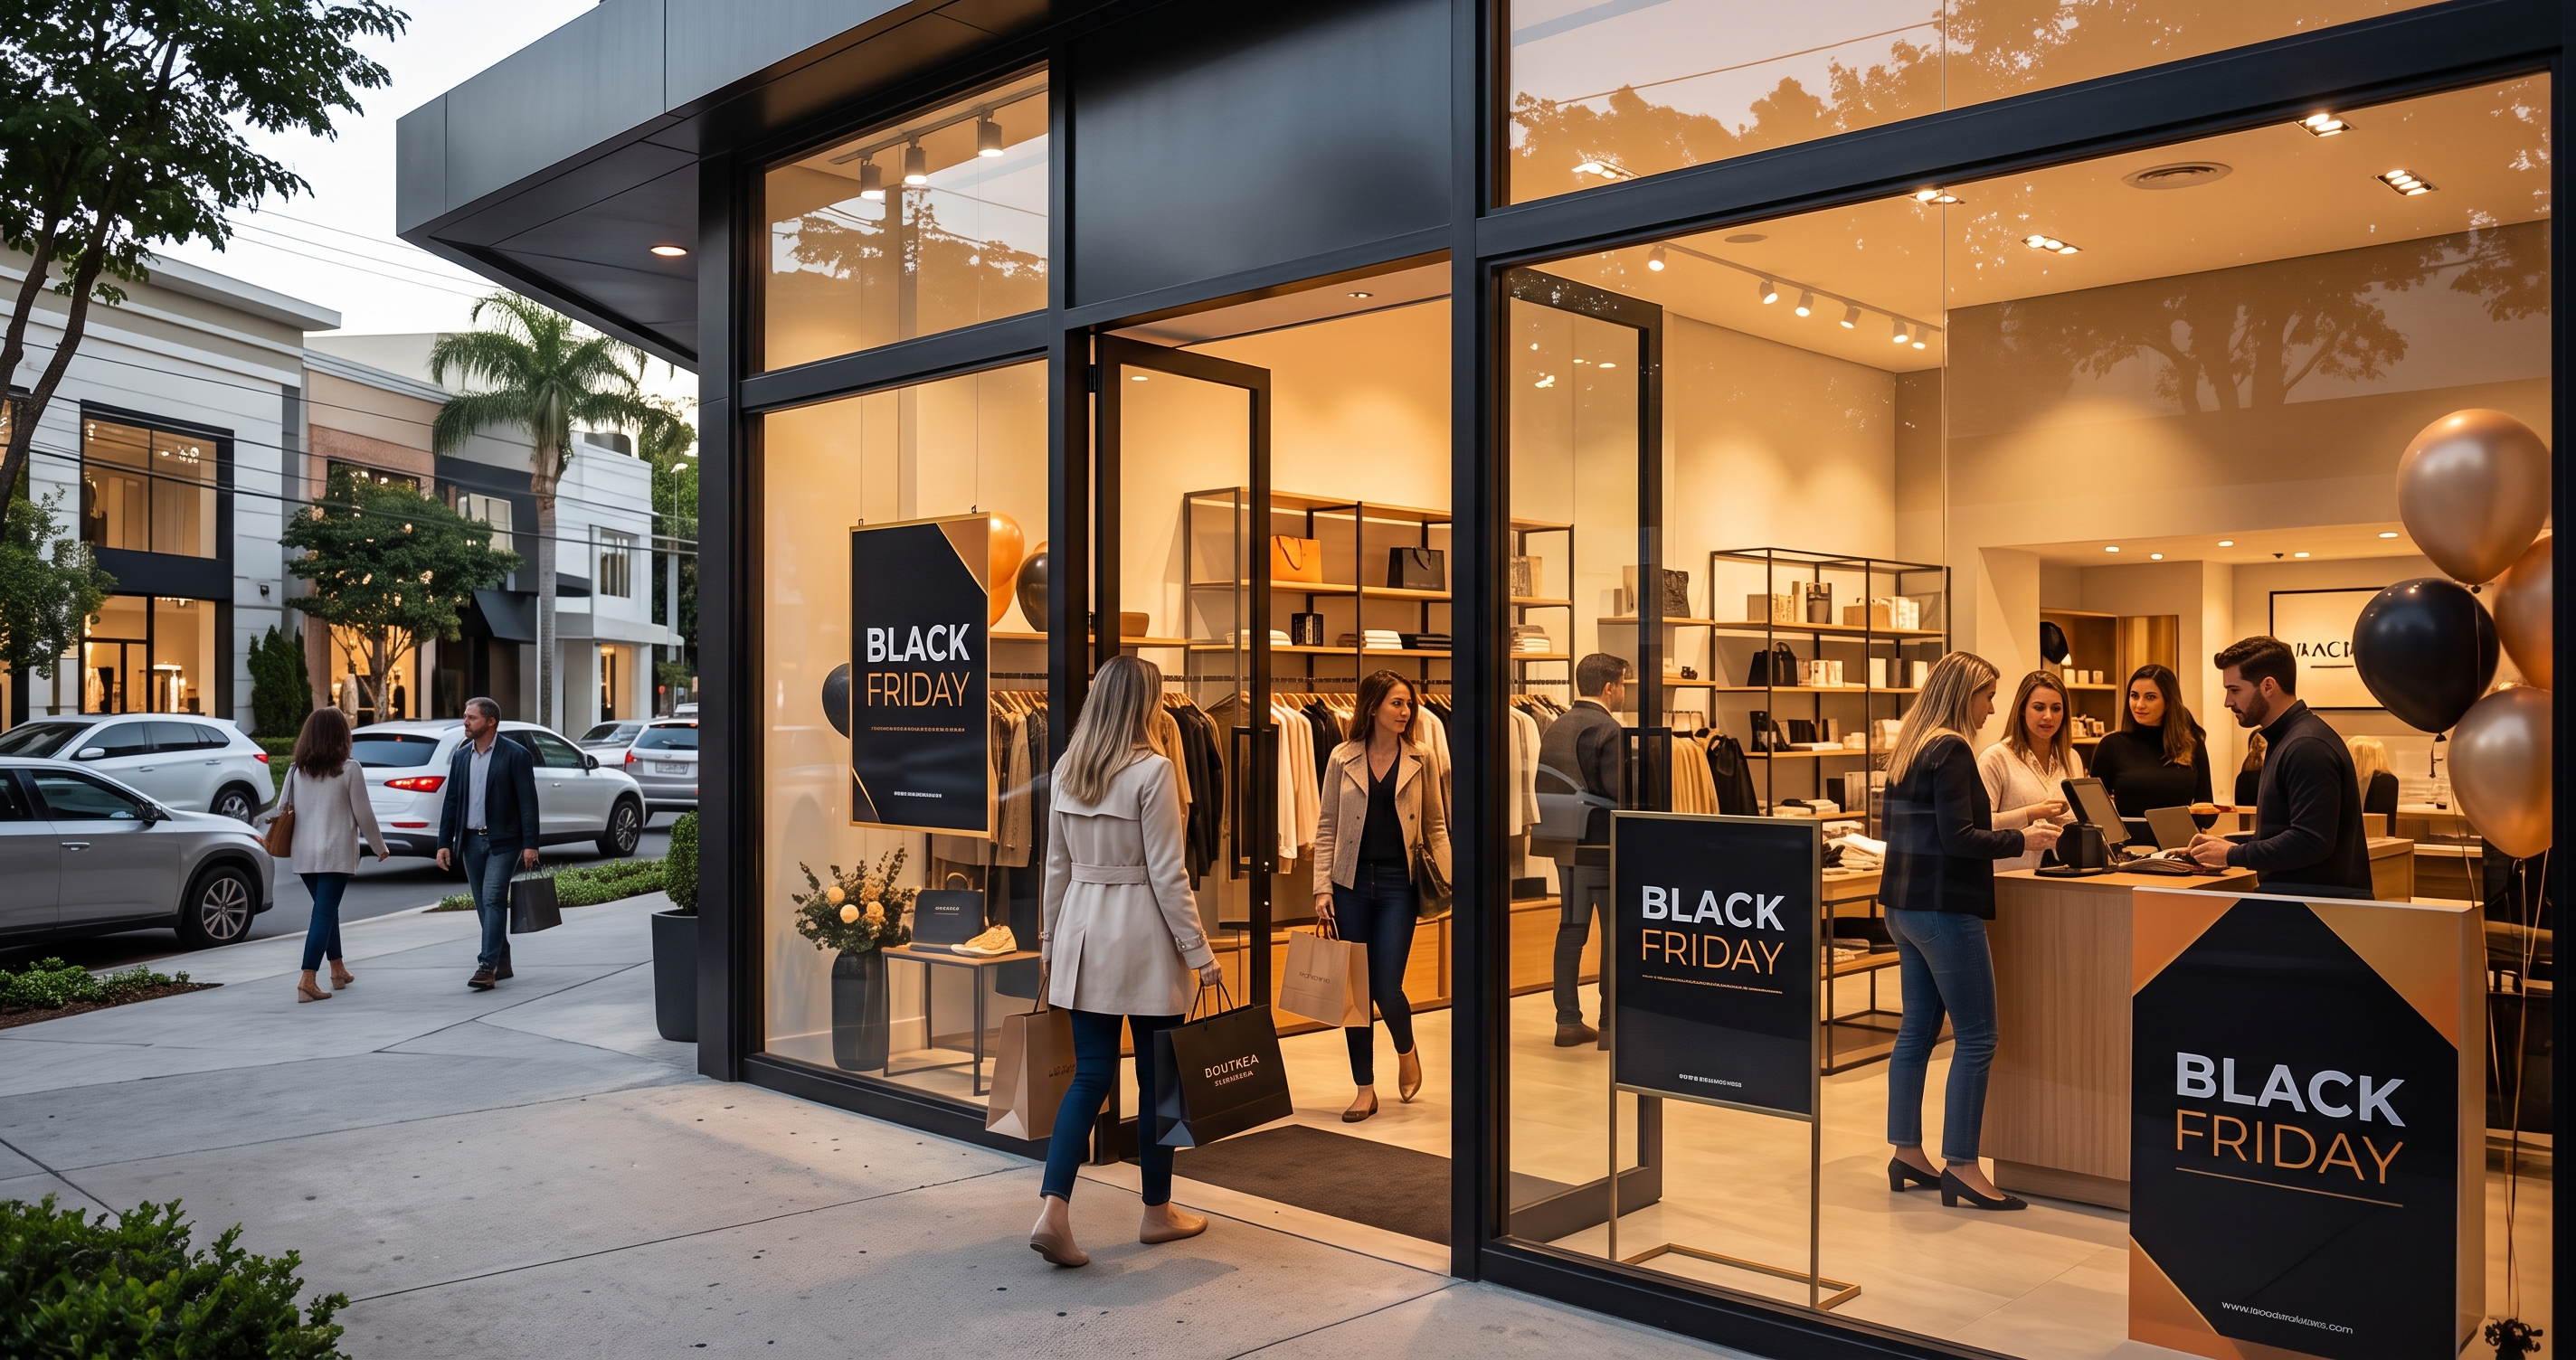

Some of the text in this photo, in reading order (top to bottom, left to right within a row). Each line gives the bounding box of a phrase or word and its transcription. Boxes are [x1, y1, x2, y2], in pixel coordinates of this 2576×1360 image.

[867, 624, 971, 662] BLACK
[867, 672, 971, 706] FRIDAY
[1642, 885, 1785, 931] BLACK
[1642, 929, 1785, 975] FRIDAY
[2176, 1052, 2406, 1128] BLACK
[2176, 1109, 2403, 1185] FRIDAY
